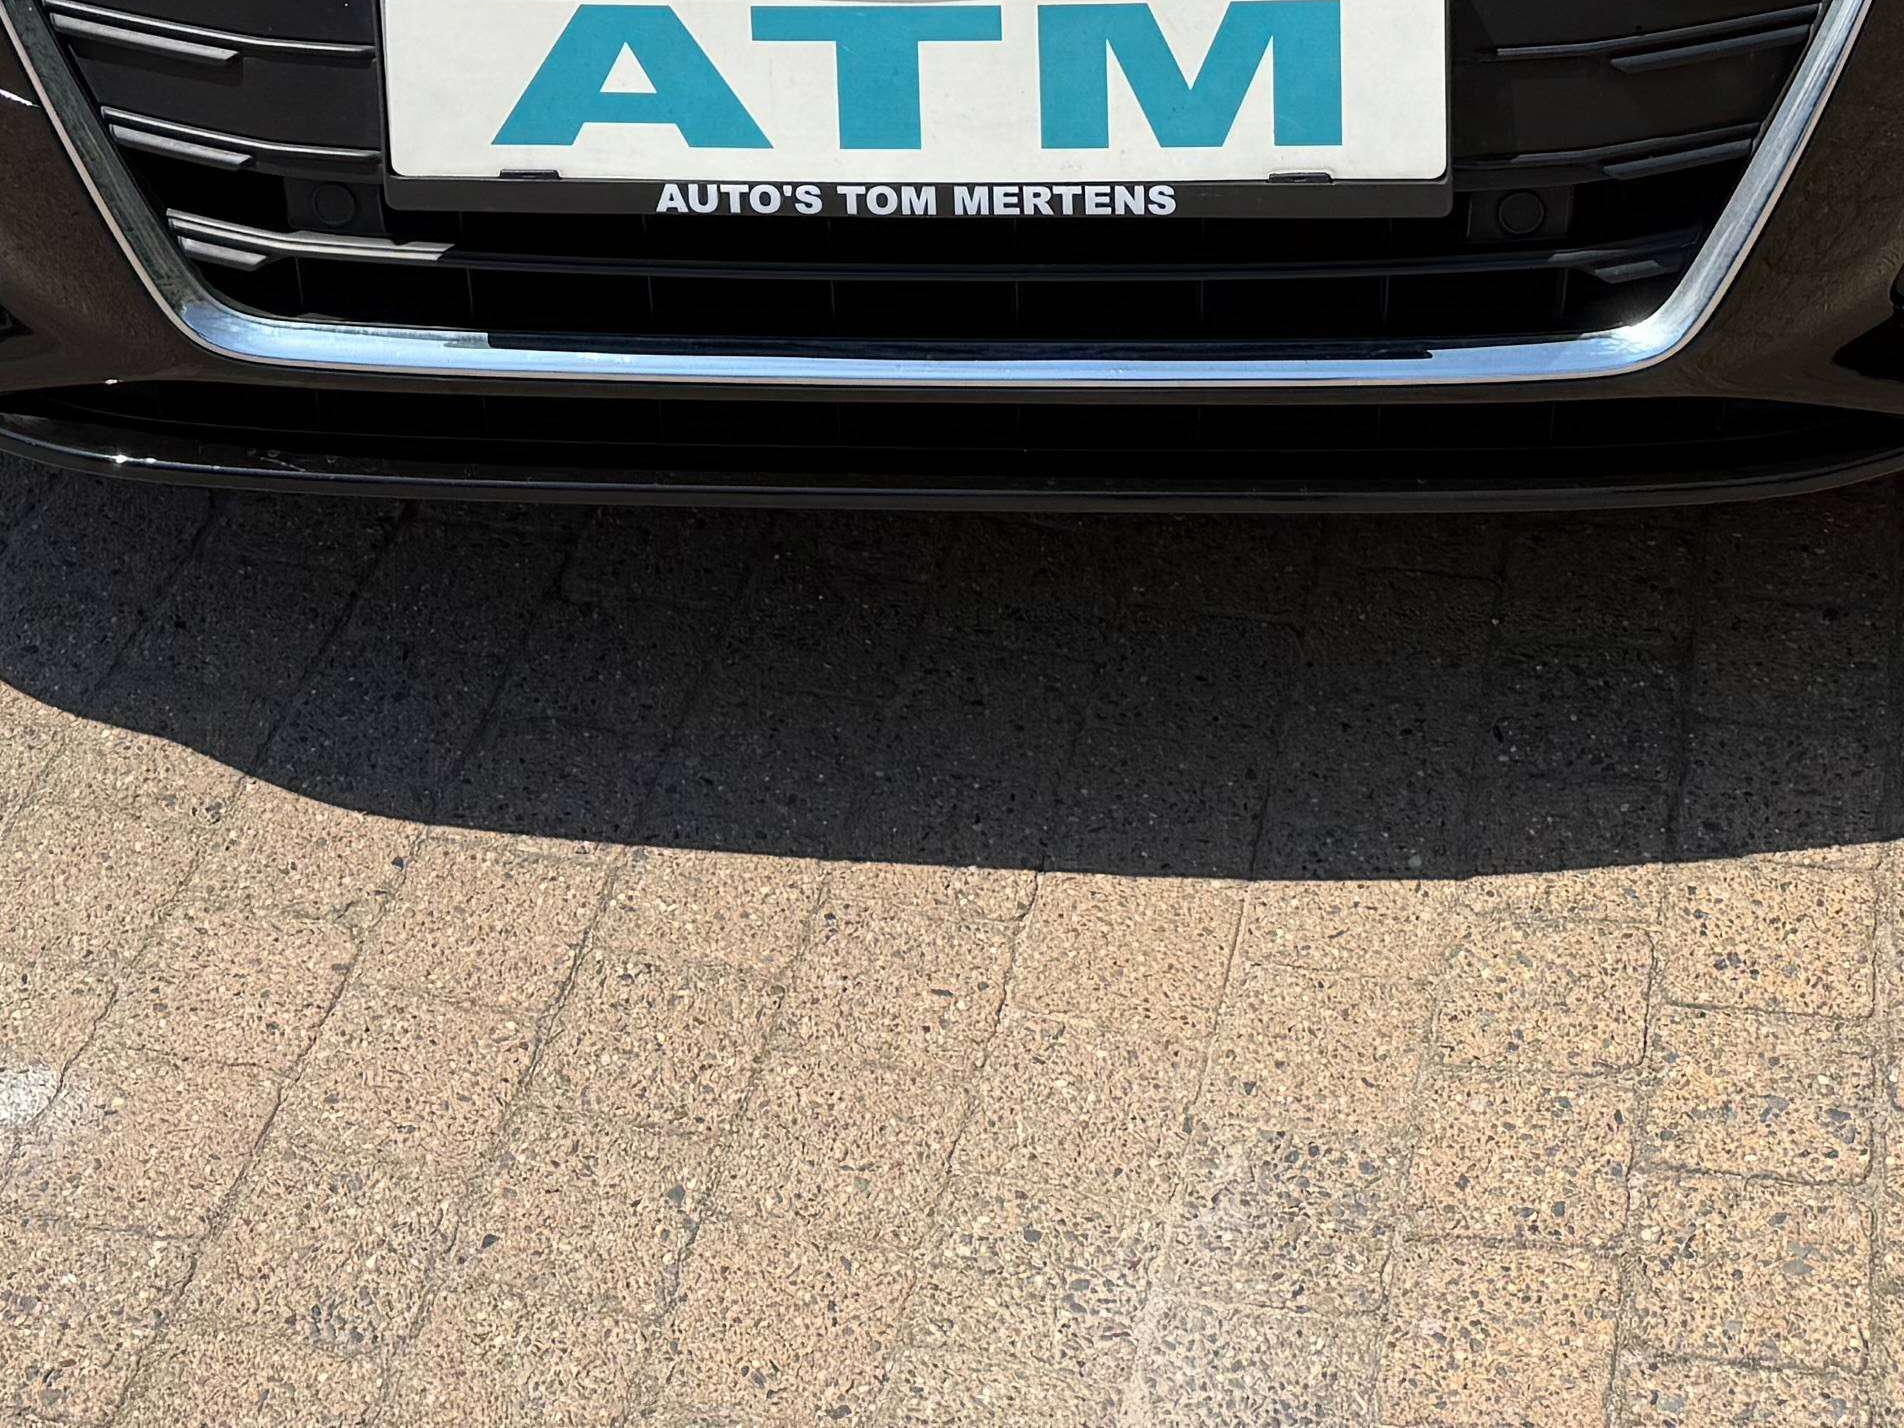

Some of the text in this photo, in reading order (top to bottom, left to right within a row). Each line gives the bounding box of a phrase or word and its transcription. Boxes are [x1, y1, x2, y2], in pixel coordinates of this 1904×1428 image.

[490, 0, 1343, 149] ATM
[655, 183, 1177, 216] AUTO'S TOM MERTENS
